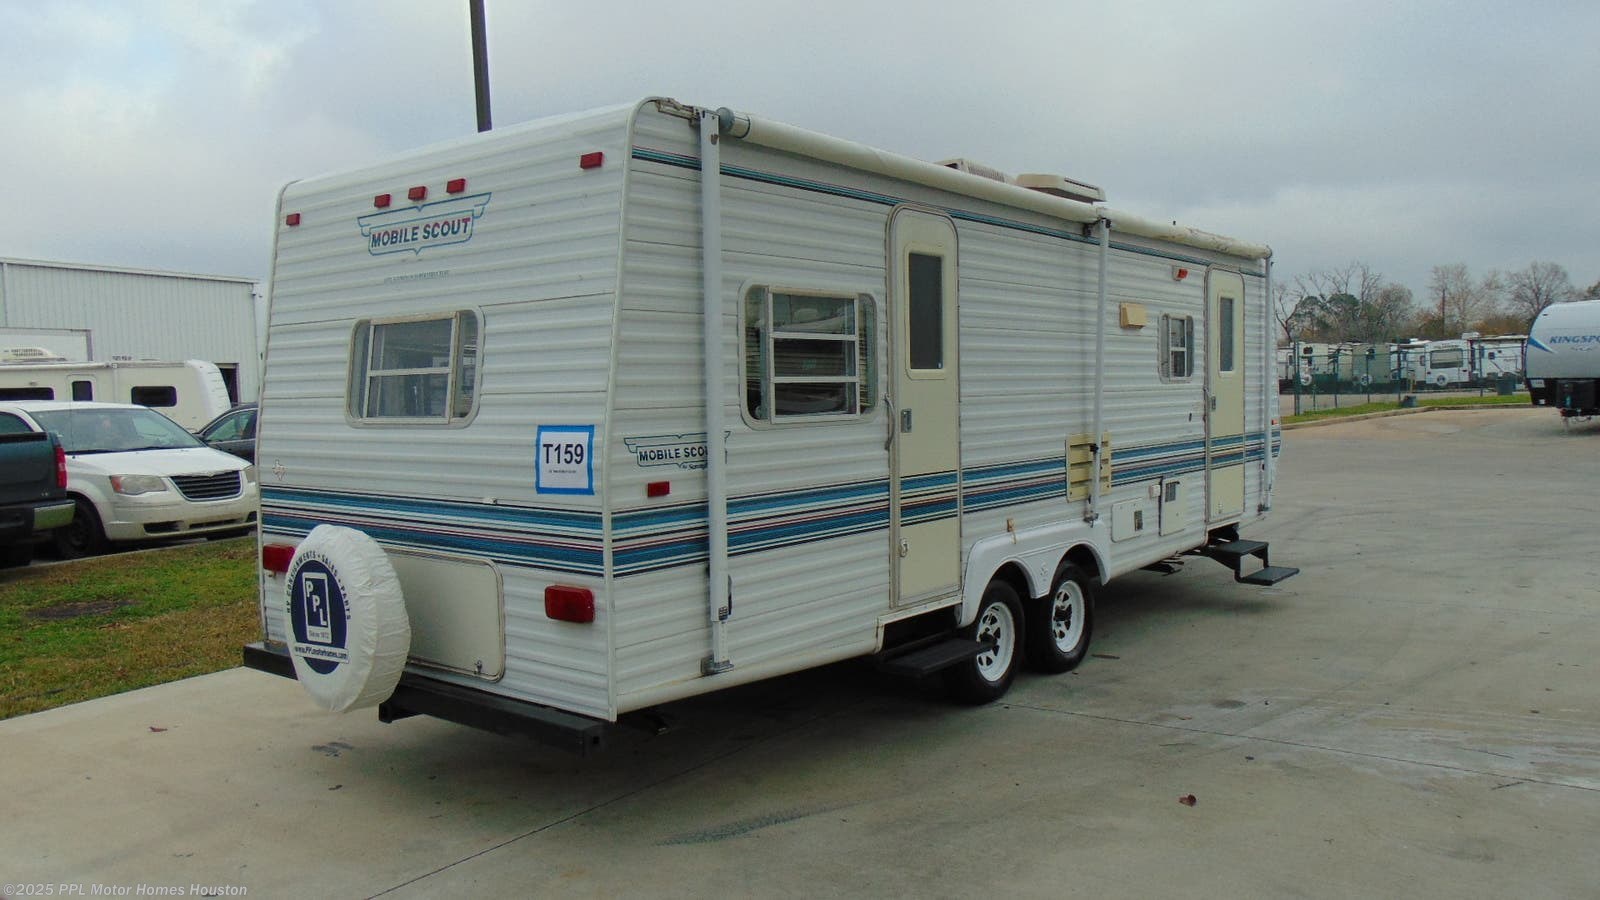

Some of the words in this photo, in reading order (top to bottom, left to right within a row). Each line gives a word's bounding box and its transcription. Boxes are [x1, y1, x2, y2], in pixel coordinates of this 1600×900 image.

[371, 226, 420, 248] MOBILE
[423, 217, 471, 240] SCOUT
[543, 443, 584, 465] T159
[639, 448, 681, 461] MOBILE
